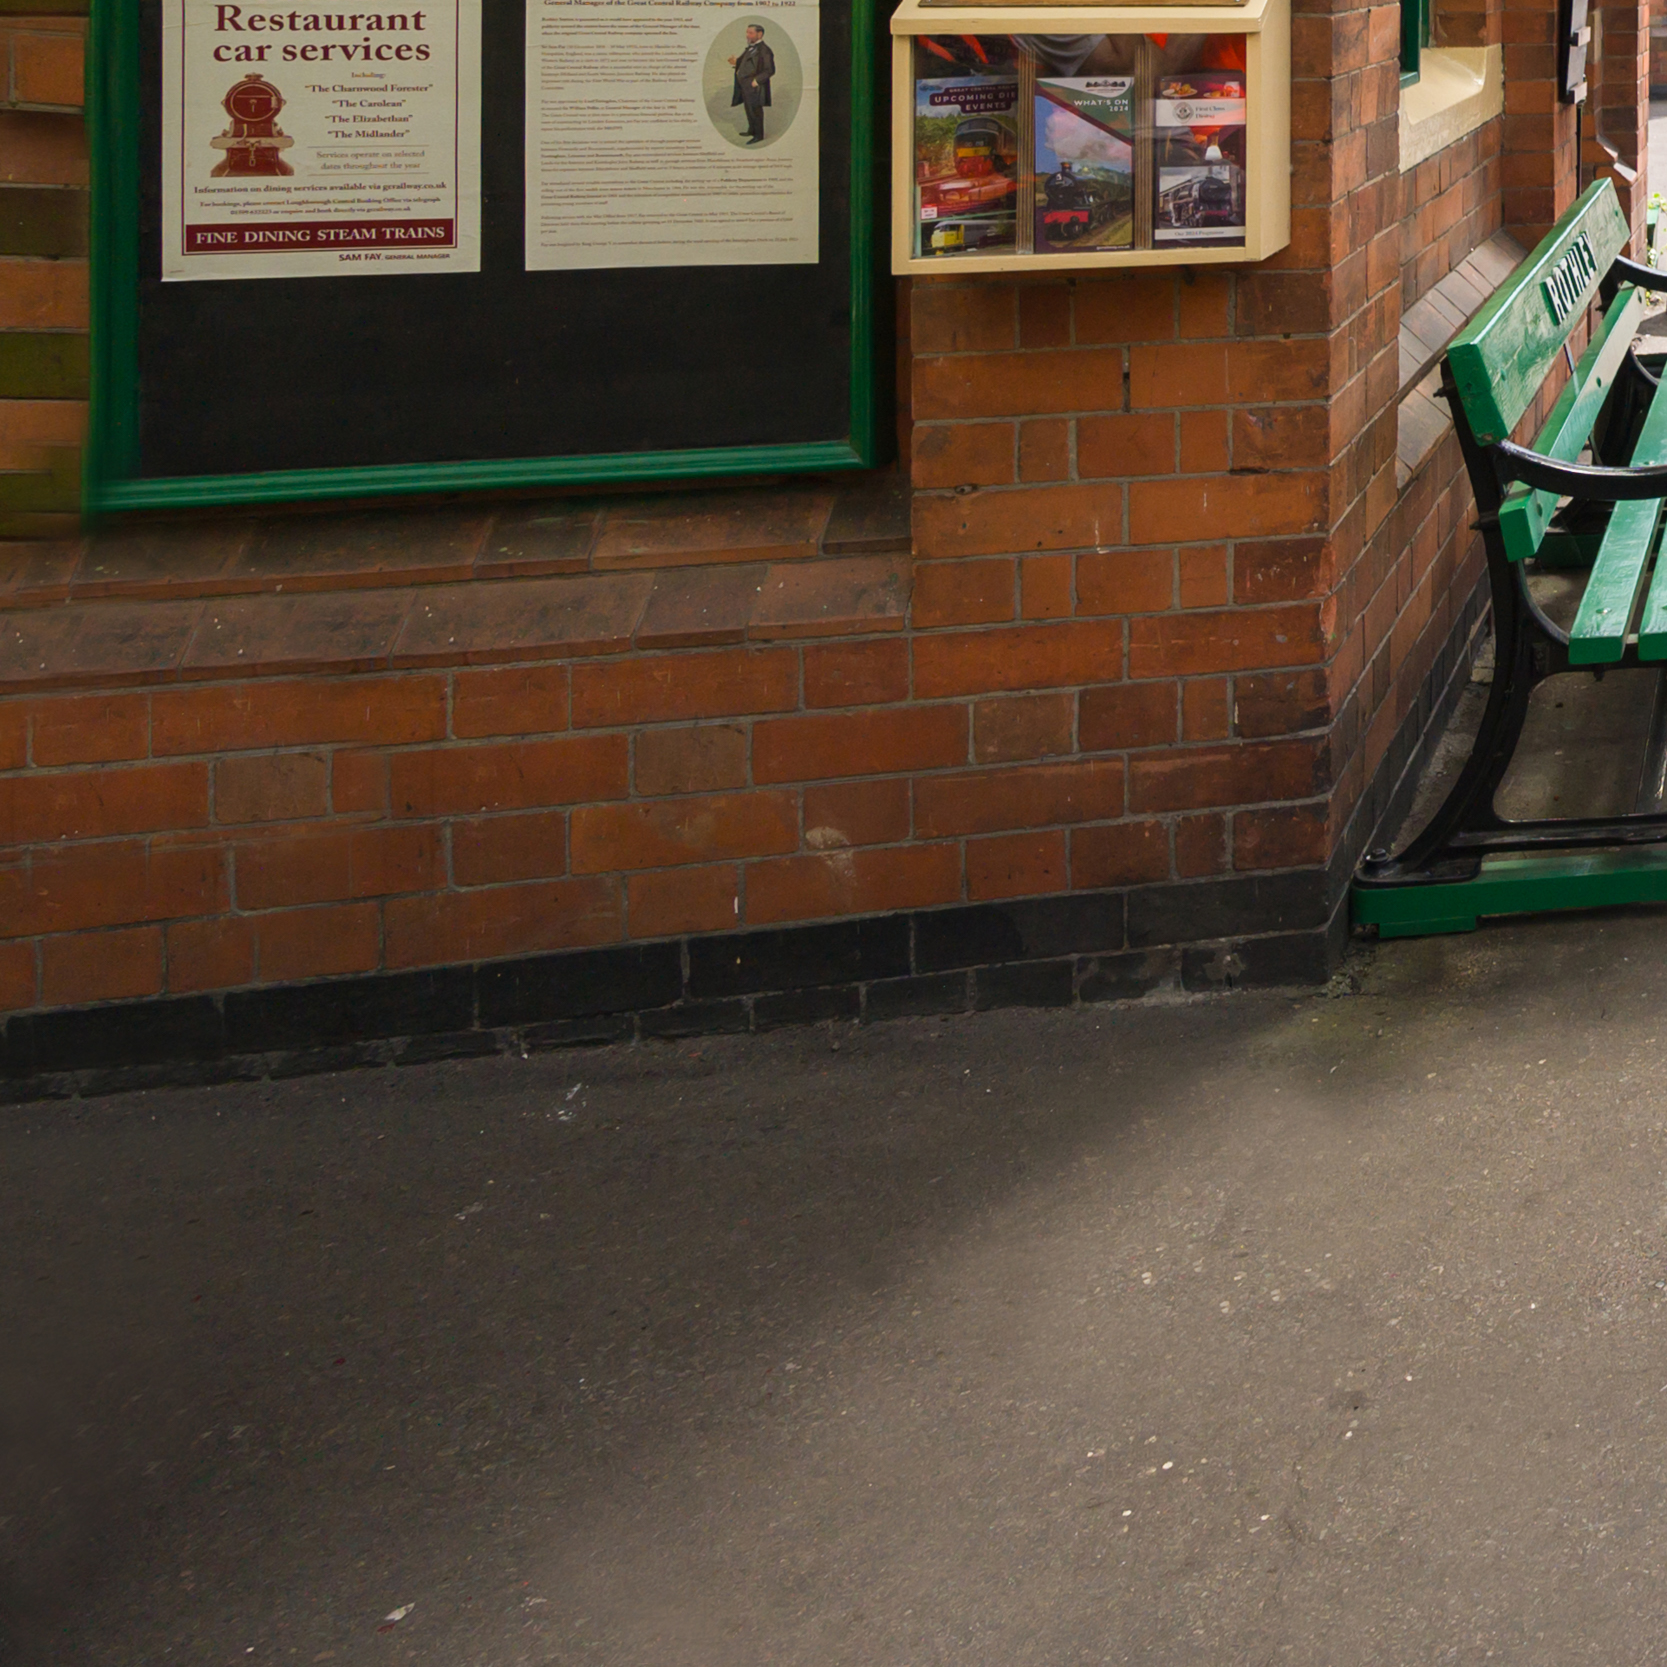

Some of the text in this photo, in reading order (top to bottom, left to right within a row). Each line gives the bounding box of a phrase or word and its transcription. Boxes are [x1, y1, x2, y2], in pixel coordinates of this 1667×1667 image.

[574, 0, 604, 7] Manager
[214, 4, 426, 31] Restaurant
[213, 37, 430, 62] car services
[332, 84, 388, 92] Charnwood
[935, 94, 993, 103] UPCOMING
[966, 102, 1006, 110] EVENTS
[264, 185, 292, 193] dining
[196, 227, 445, 244] FINE DINING STEAM TRAINS
[1545, 230, 1598, 324] ROTHLEY
